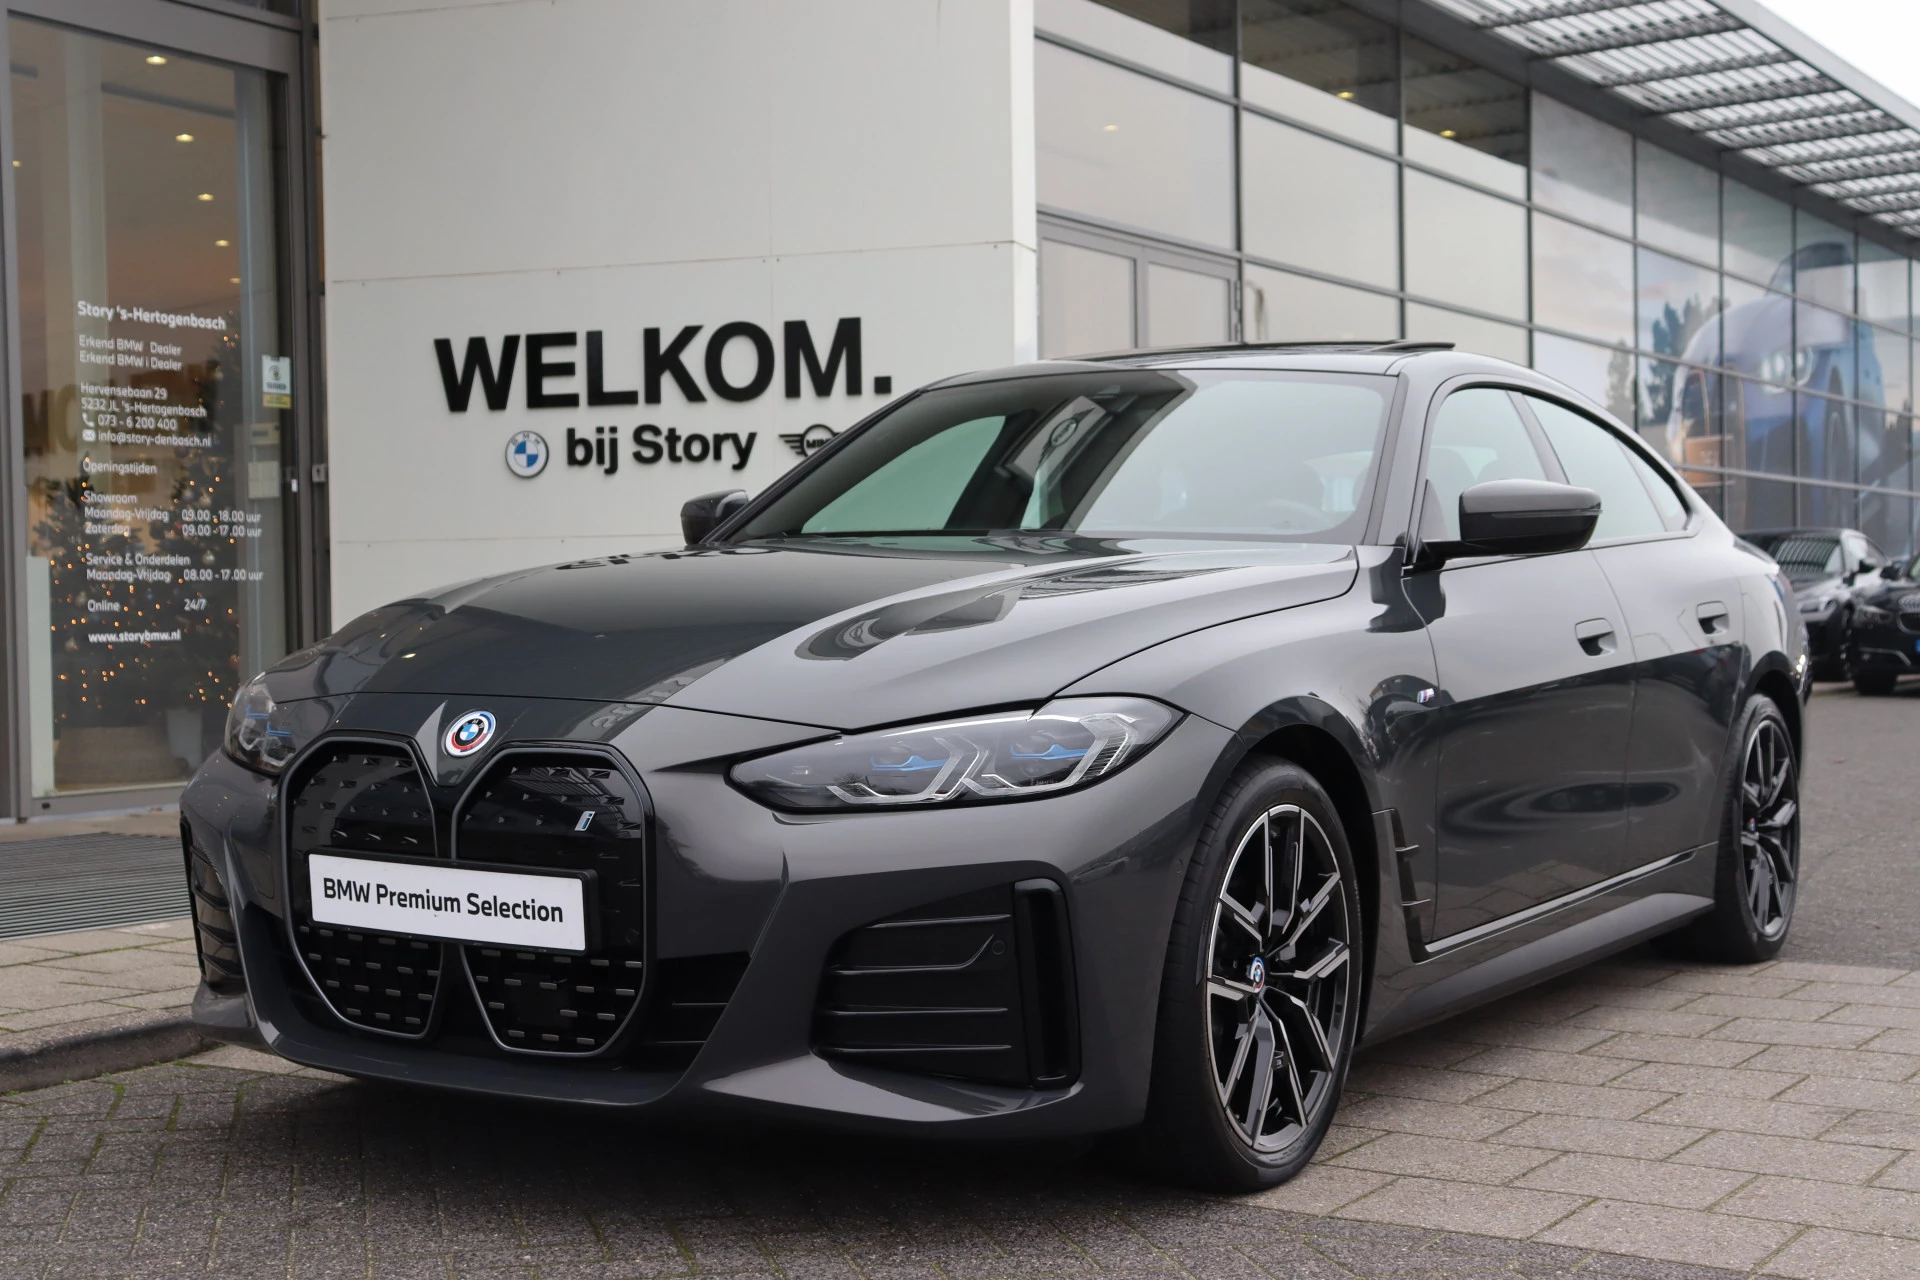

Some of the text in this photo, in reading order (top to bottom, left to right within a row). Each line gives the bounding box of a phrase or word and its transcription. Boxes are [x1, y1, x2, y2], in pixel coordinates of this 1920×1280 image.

[77, 301, 226, 330] Story 's-Hertogenbosch
[79, 335, 182, 355] Erkend BMW Dealer
[79, 351, 115, 365] Erkend
[117, 354, 144, 367] BMW
[150, 357, 182, 370] Dealer
[434, 317, 892, 413] WELKOM.
[81, 383, 168, 400] Hervensebaan 29
[81, 399, 207, 417] 5232 JL 's-Hertogenbosch
[98, 415, 116, 426] 073
[126, 416, 134, 427] 6
[135, 417, 154, 429] 200
[157, 418, 177, 430] 400
[98, 430, 212, 447] info@story-denbosch.nl
[566, 424, 758, 475] bij Story
[83, 460, 158, 476] Openingstijden
[83, 491, 138, 504] Showroom
[84, 507, 169, 523] Maandag-Vrijdag
[182, 509, 210, 521] 09.00
[218, 510, 245, 522] 18.00
[246, 512, 261, 522] uur
[85, 522, 130, 536] Zaterdag
[182, 524, 211, 536] 09.00
[219, 525, 245, 536] 17.00
[246, 527, 262, 537] uur
[86, 553, 190, 566] Service & Onderdelen
[87, 569, 171, 583] Maandag-Vrijdag
[183, 569, 212, 581] 08.00
[221, 569, 247, 581] 17.00
[248, 571, 263, 581] uur
[87, 599, 207, 612] Online 24/7
[88, 629, 181, 643] www.storybmw.nl
[323, 877, 563, 923] BMW Premium Selection
